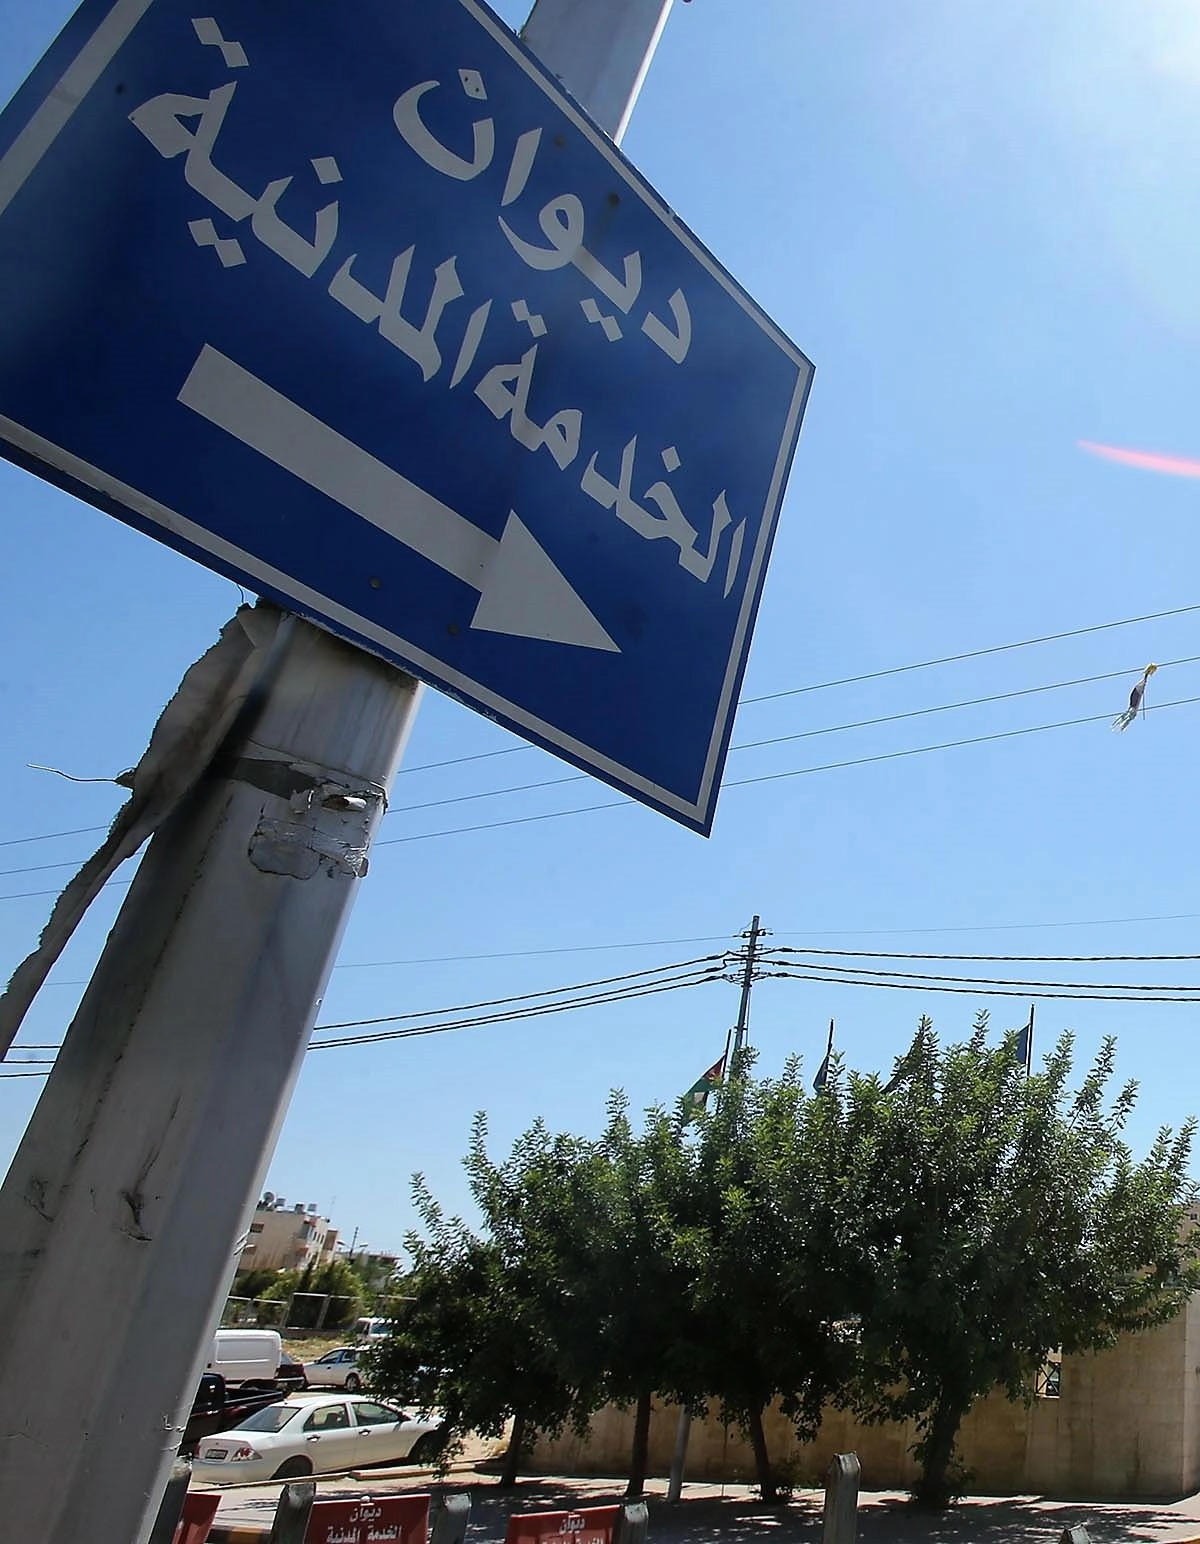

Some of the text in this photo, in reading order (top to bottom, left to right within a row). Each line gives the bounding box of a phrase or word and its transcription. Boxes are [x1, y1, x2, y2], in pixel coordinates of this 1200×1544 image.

[393, 67, 692, 366] ديوان
[127, 16, 747, 600] الخدمة المدنية
[349, 1506, 382, 1522] ديوان
[326, 1524, 402, 1543] الخدمة المدنية
[559, 1518, 585, 1535] ديوان
